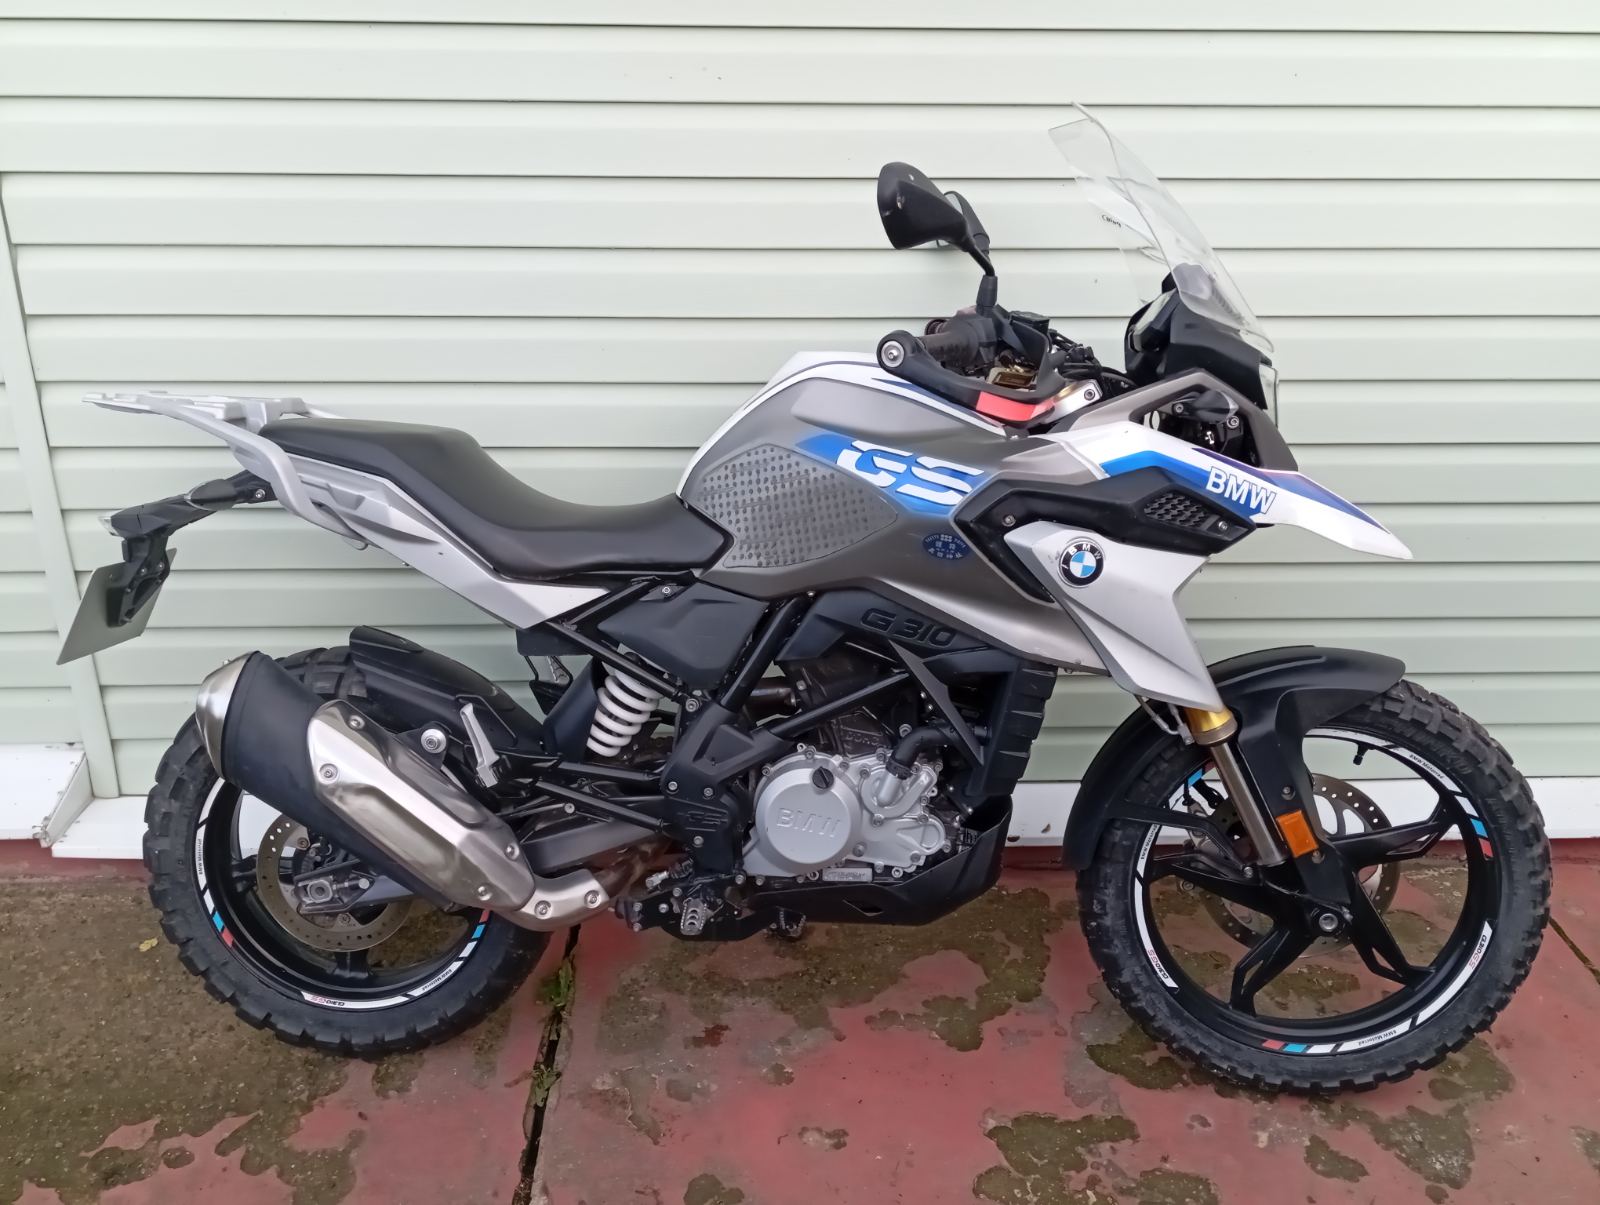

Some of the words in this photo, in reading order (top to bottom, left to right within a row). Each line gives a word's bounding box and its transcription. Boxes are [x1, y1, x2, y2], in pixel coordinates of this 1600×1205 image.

[836, 439, 985, 506] GS
[1205, 465, 1278, 515] BMW
[1068, 542, 1102, 560] BMW
[860, 607, 897, 634] G
[893, 618, 957, 648] 310
[776, 807, 841, 839] BMW
[1469, 934, 1488, 970] G310GS
